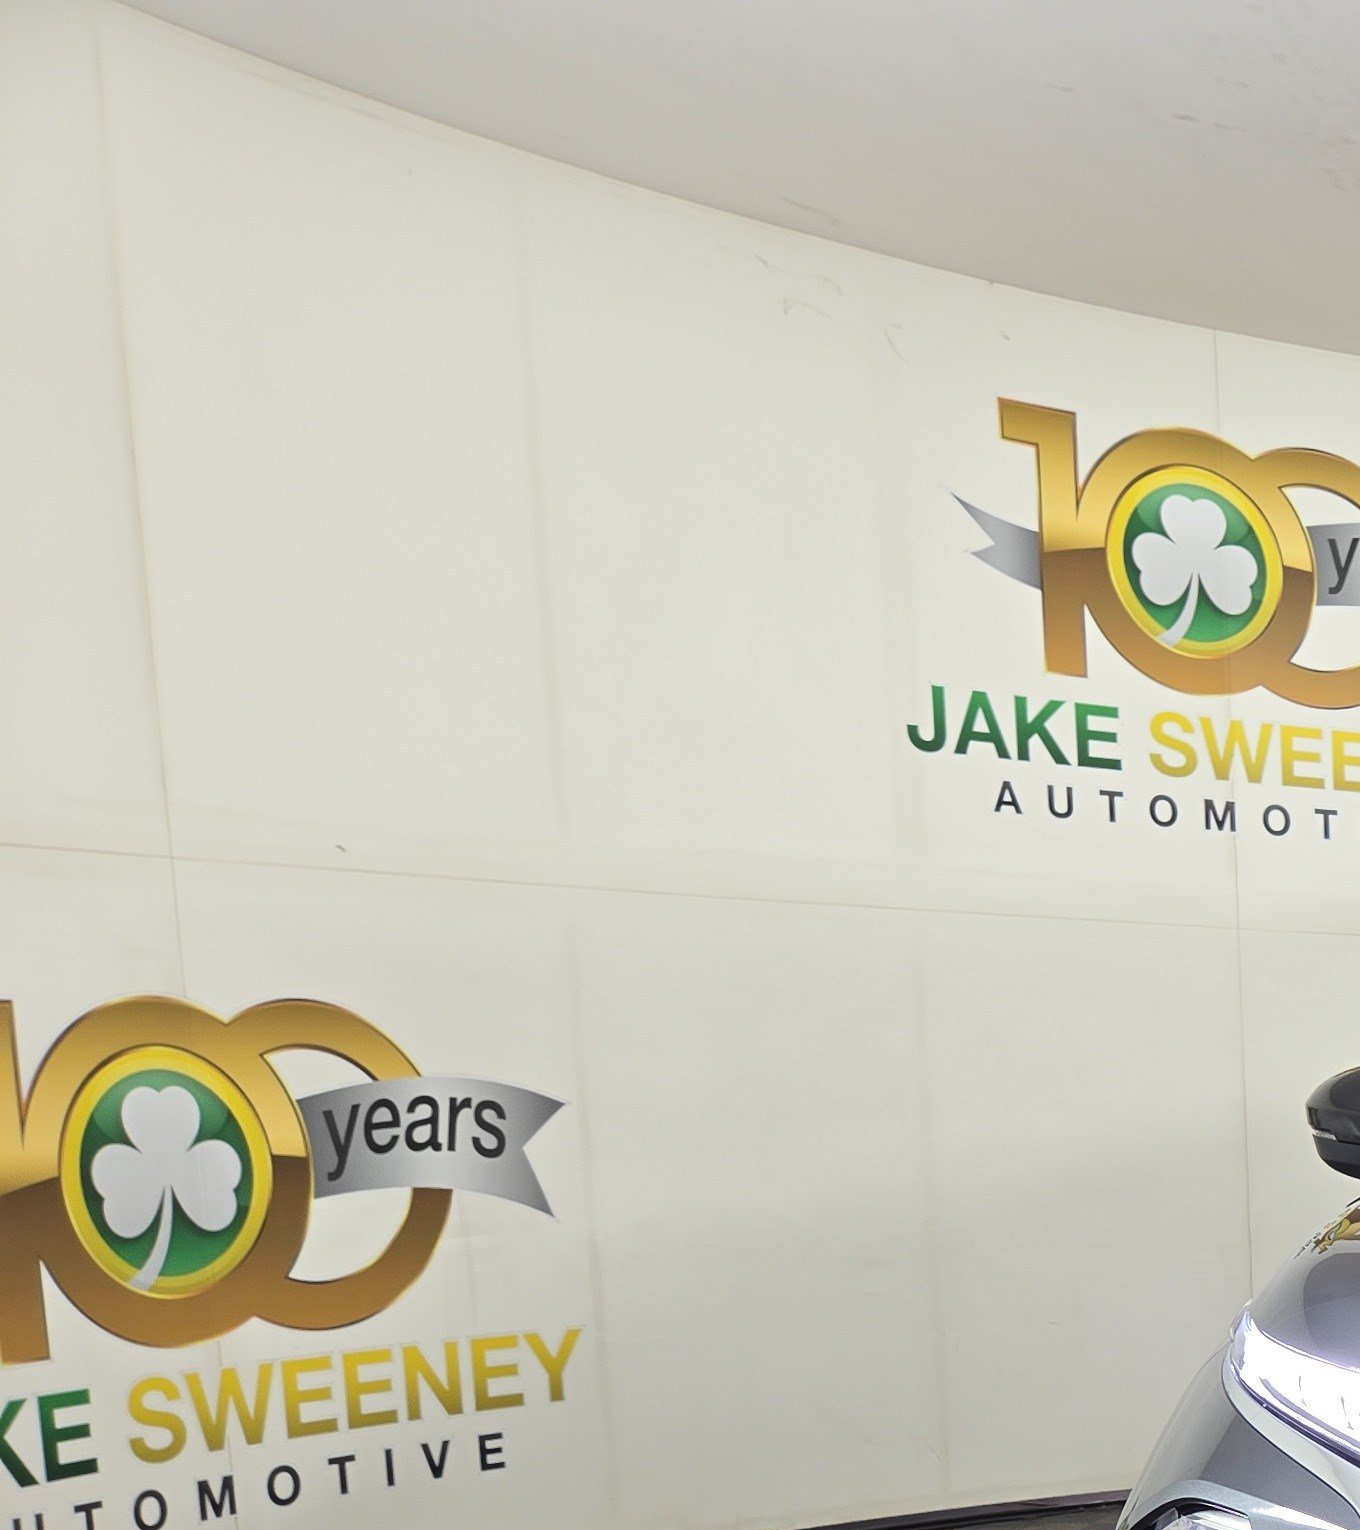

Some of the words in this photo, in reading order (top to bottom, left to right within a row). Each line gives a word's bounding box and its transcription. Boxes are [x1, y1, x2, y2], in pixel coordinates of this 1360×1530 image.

[906, 685, 1122, 771] JAKE
[322, 1094, 507, 1181] years
[127, 1328, 582, 1463] SWEENEY
